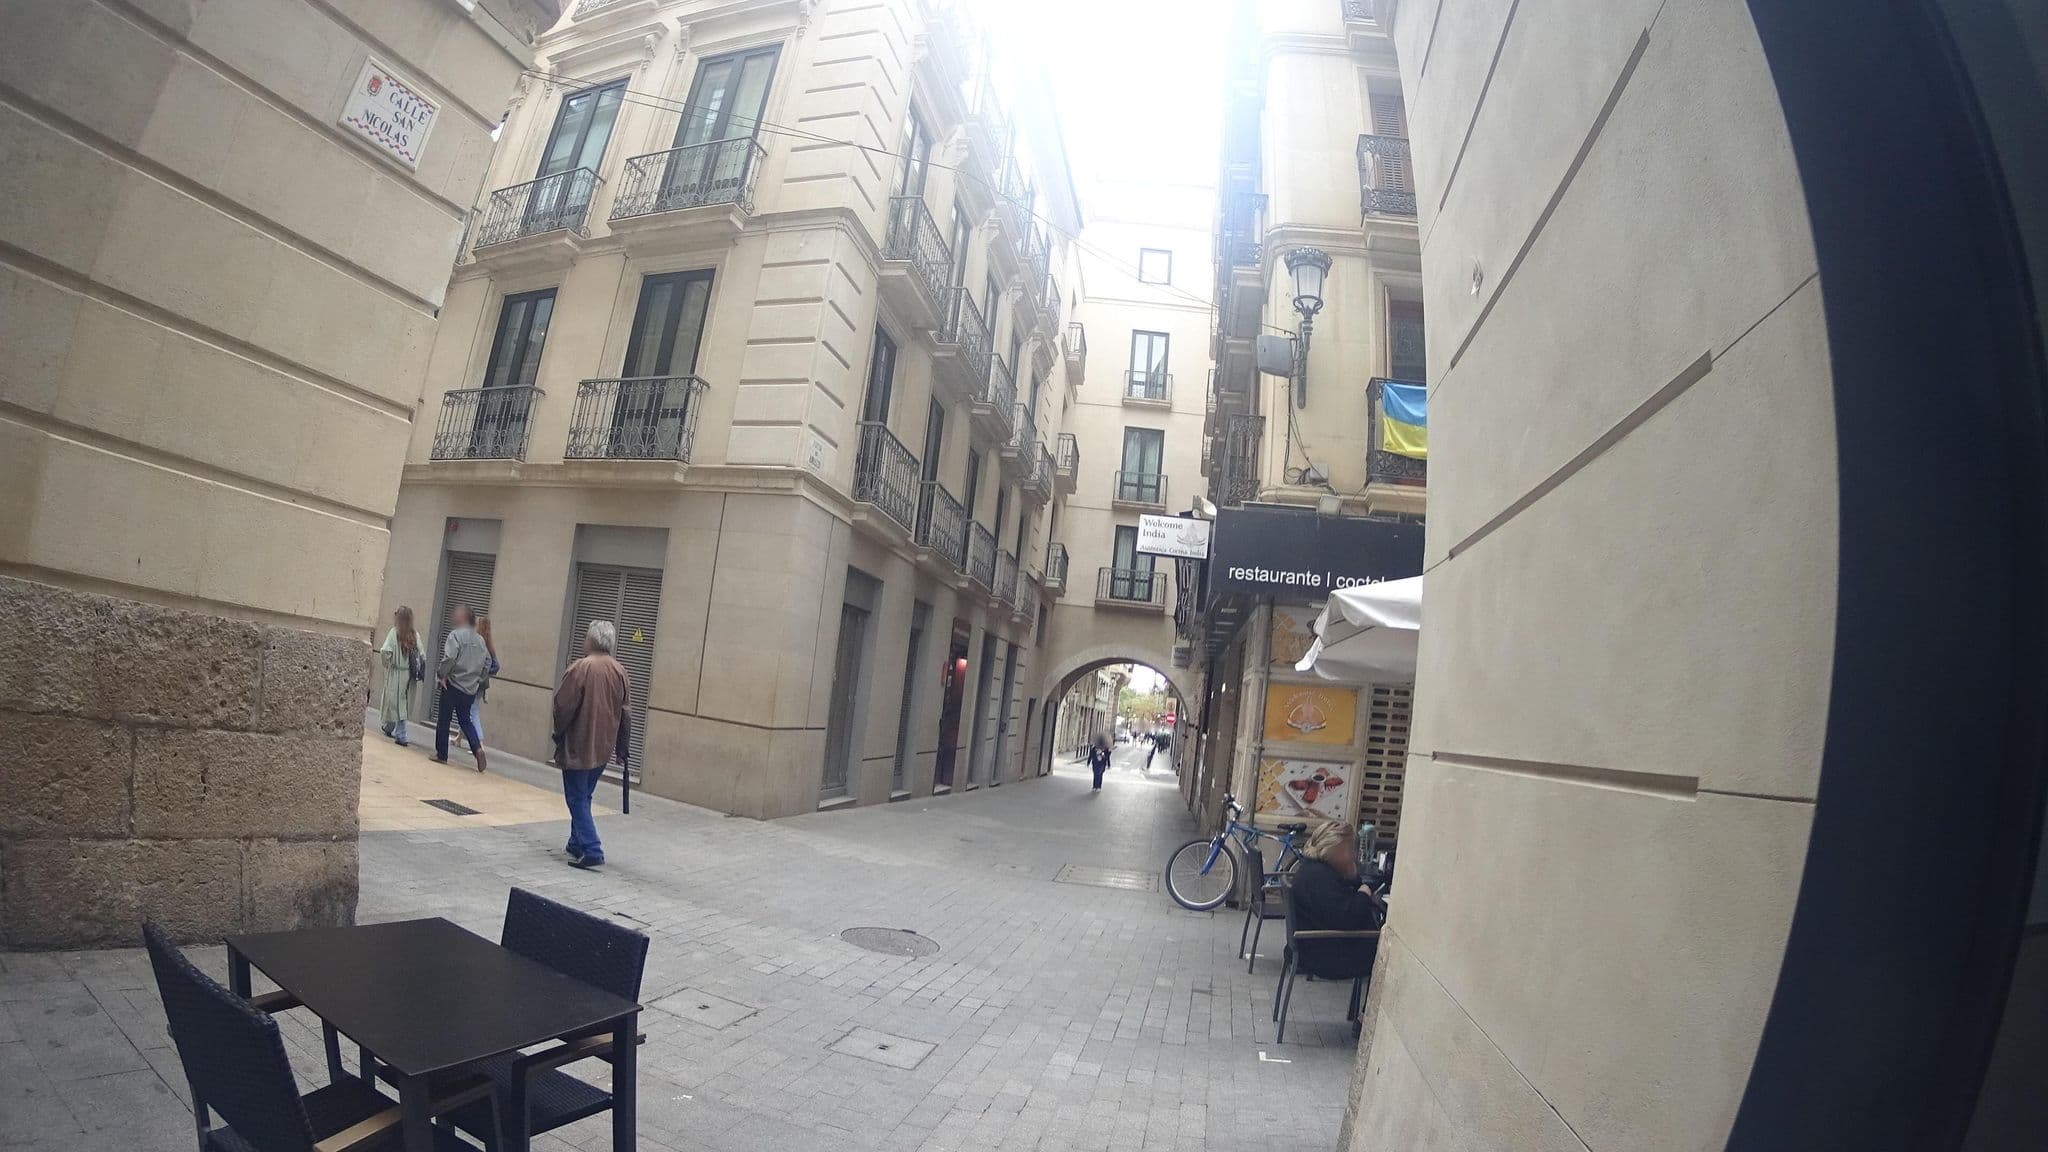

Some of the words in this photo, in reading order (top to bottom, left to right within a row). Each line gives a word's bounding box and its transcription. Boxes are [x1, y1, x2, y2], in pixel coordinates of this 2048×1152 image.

[389, 92, 425, 125] CALLE
[362, 109, 409, 147] NICOLAS
[392, 111, 416, 132] SAN
[1142, 528, 1166, 539] India
[1143, 518, 1184, 530] Welcome
[1228, 566, 1321, 587] restaurante
